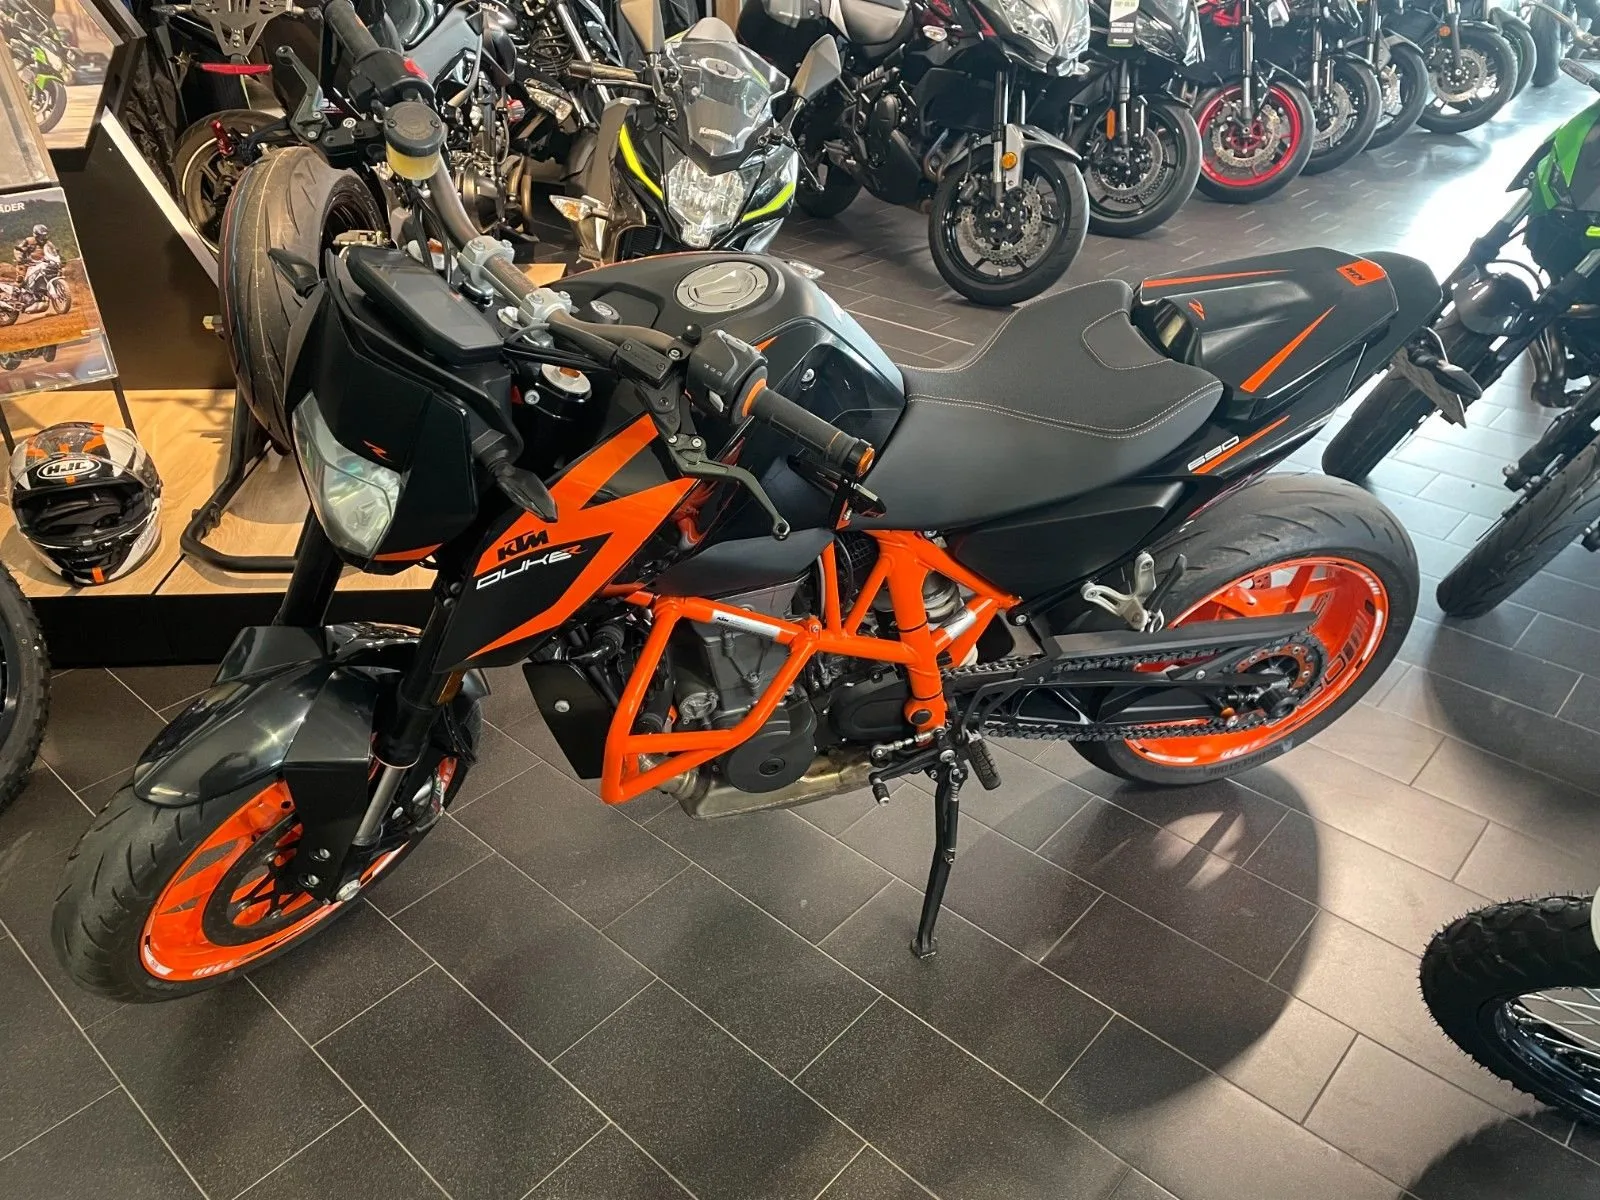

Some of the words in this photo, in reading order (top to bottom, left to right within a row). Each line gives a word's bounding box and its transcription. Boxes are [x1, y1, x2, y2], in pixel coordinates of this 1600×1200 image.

[47, 461, 88, 475] HJC
[1187, 435, 1240, 471] 690
[497, 529, 549, 562] KTM
